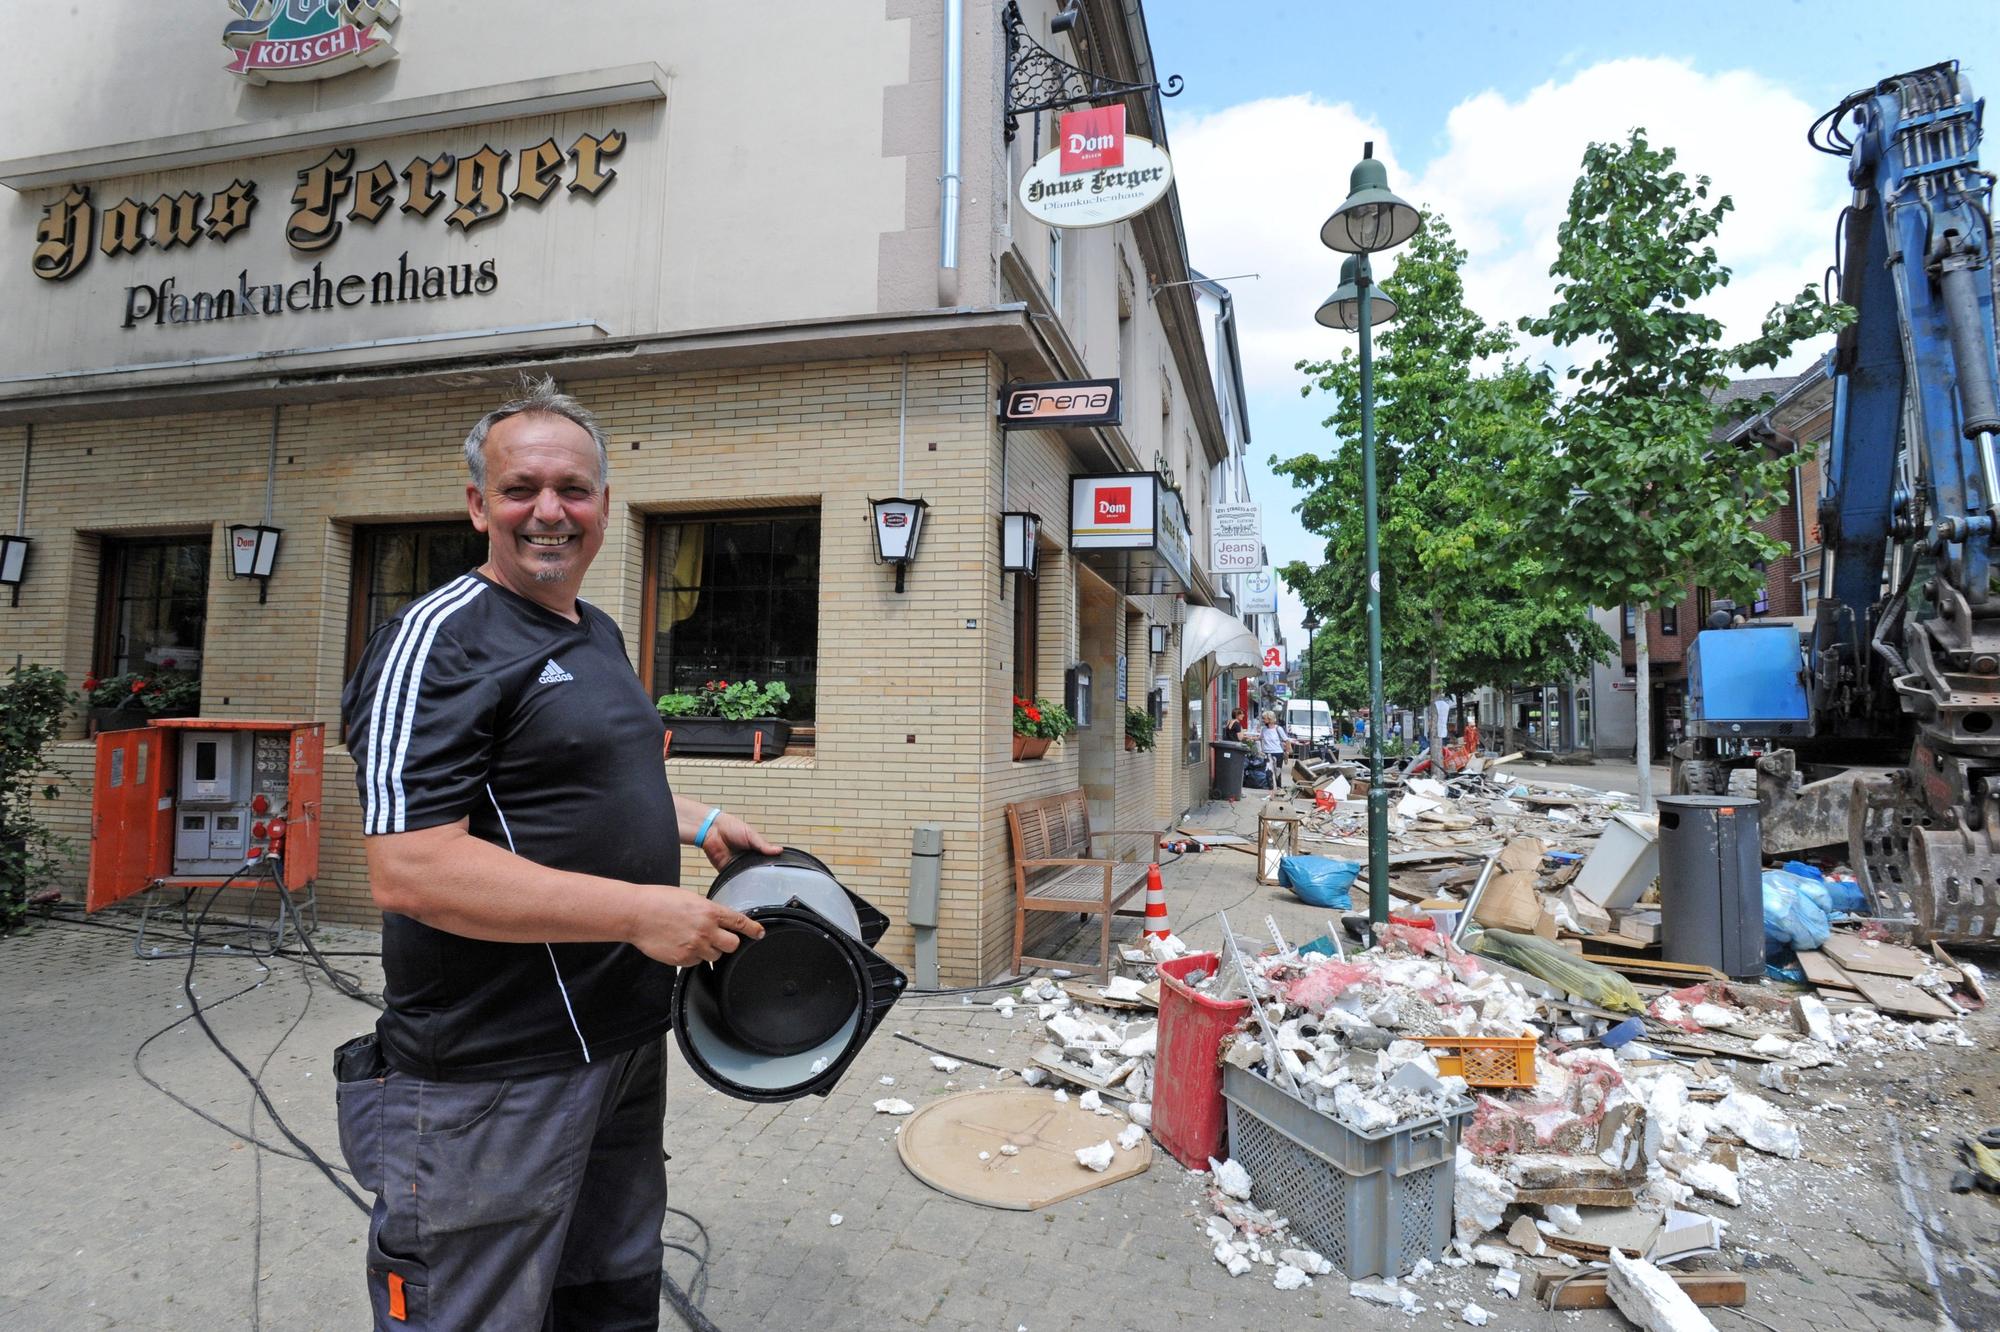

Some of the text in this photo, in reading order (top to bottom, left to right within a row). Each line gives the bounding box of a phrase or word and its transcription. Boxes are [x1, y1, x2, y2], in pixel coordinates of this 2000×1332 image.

[257, 32, 346, 63] KÖLSCH
[1069, 133, 1114, 154] Dom
[1028, 166, 1164, 202] Haus Ferger
[32, 128, 626, 281] Haus Ferger
[1043, 191, 1145, 211] Pfannkuchenhaus
[120, 250, 499, 329] Pfannkuchenhaus
[1018, 393, 1108, 413] arena
[1099, 500, 1126, 514] Dom
[236, 536, 255, 548] Dom
[1218, 542, 1255, 553] Jeans
[1220, 554, 1254, 566] Shop
[538, 672, 574, 684] adidas
